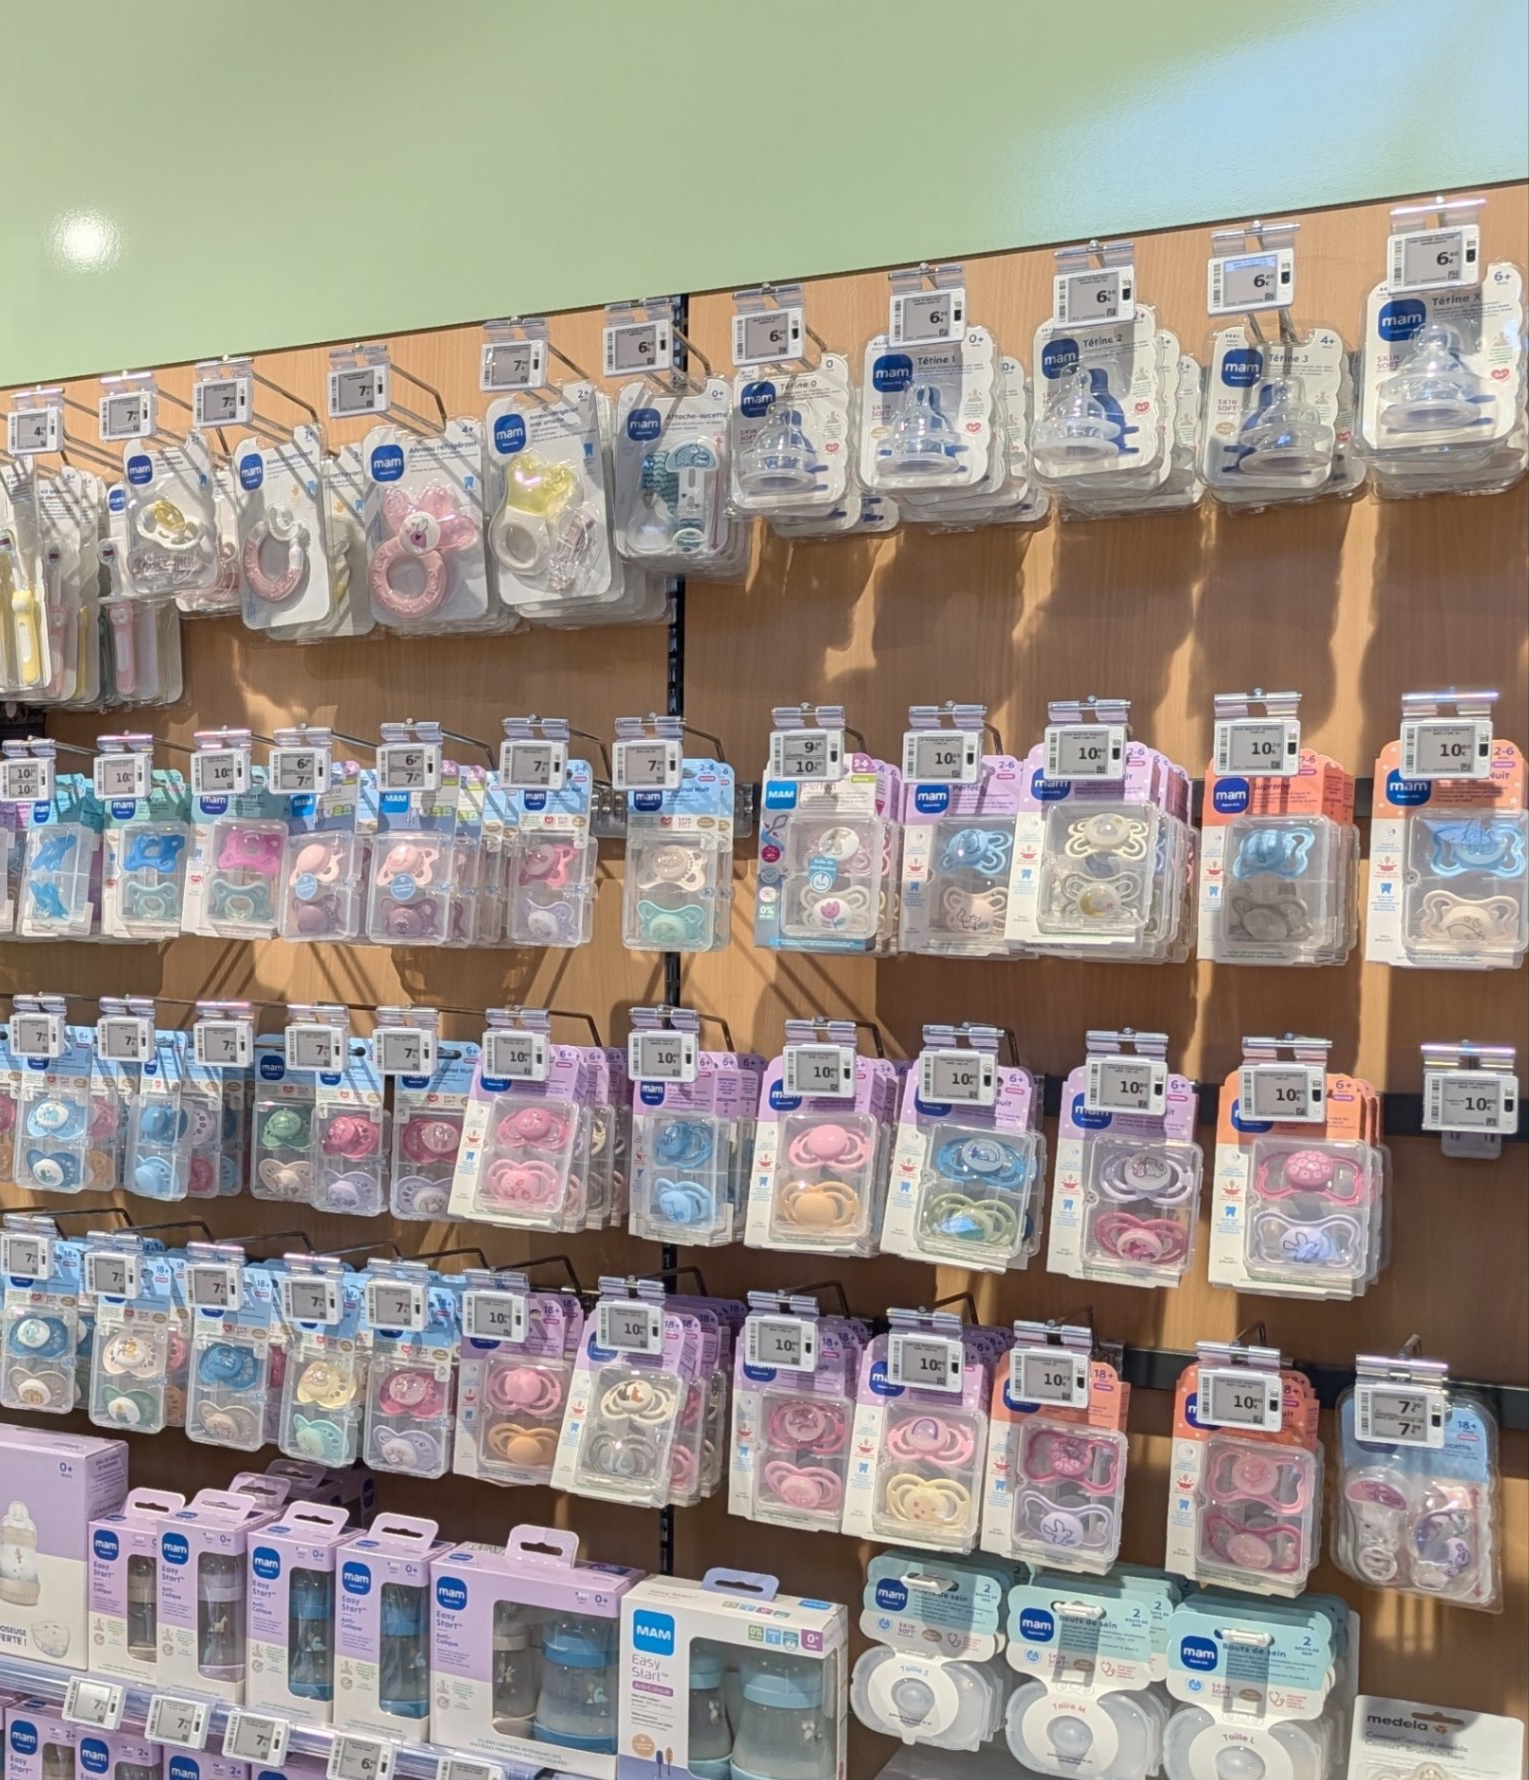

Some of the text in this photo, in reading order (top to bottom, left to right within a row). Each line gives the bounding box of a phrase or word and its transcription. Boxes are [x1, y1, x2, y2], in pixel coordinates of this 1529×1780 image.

[1495, 272, 1511, 281] 6+
[1432, 294, 1470, 306] Tétine
[1382, 313, 1422, 327] mam
[970, 334, 984, 344] 0+
[1084, 334, 1122, 347] Tétine 2
[1320, 336, 1335, 345] 4+
[918, 354, 949, 366] Tétine
[1044, 351, 1076, 365] mam
[1269, 353, 1308, 363] Tétine 3
[1377, 355, 1400, 363] SKIN
[1225, 362, 1259, 373] mam
[876, 367, 910, 379] mam
[780, 380, 817, 391] Tétine 0
[578, 389, 589, 398] 2+
[712, 390, 724, 398] 0+
[744, 392, 772, 404] mam
[630, 420, 658, 430] mam
[462, 426, 473, 435] 4+
[497, 428, 523, 439] mam
[374, 457, 402, 468] mam
[129, 466, 151, 475] mam
[241, 467, 262, 477] mam
[700, 764, 714, 772] 2-6
[999, 761, 1014, 769] 2-6
[1389, 780, 1428, 792] mam
[769, 790, 794, 798] MAM
[918, 792, 946, 801] mam
[1216, 789, 1245, 800] mam
[1009, 1074, 1024, 1085] 6+
[1171, 1079, 1185, 1091] 6+
[1336, 1079, 1352, 1091] 6+
[822, 1337, 839, 1346] 18+
[1094, 1369, 1113, 1379] 18+
[1458, 1420, 1478, 1430] 18+
[60, 1462, 73, 1472] 0+
[220, 1535, 231, 1543] 0+
[164, 1543, 187, 1554] mam
[162, 1566, 178, 1575] Easy
[344, 1573, 369, 1584] mam
[439, 1588, 464, 1599] mam
[342, 1596, 360, 1605] Easy
[1022, 1619, 1051, 1630] mam
[637, 1626, 670, 1640] MAM
[750, 1628, 762, 1636] 0%
[1303, 1637, 1310, 1647] 2
[1184, 1647, 1215, 1660] mam
[1267, 1649, 1286, 1658] sein
[632, 1654, 660, 1669] Easy
[1052, 1703, 1074, 1711] Taille
[1368, 1714, 1428, 1731] medela
[1223, 1733, 1244, 1743] Taille
[82, 1749, 106, 1761] mam
